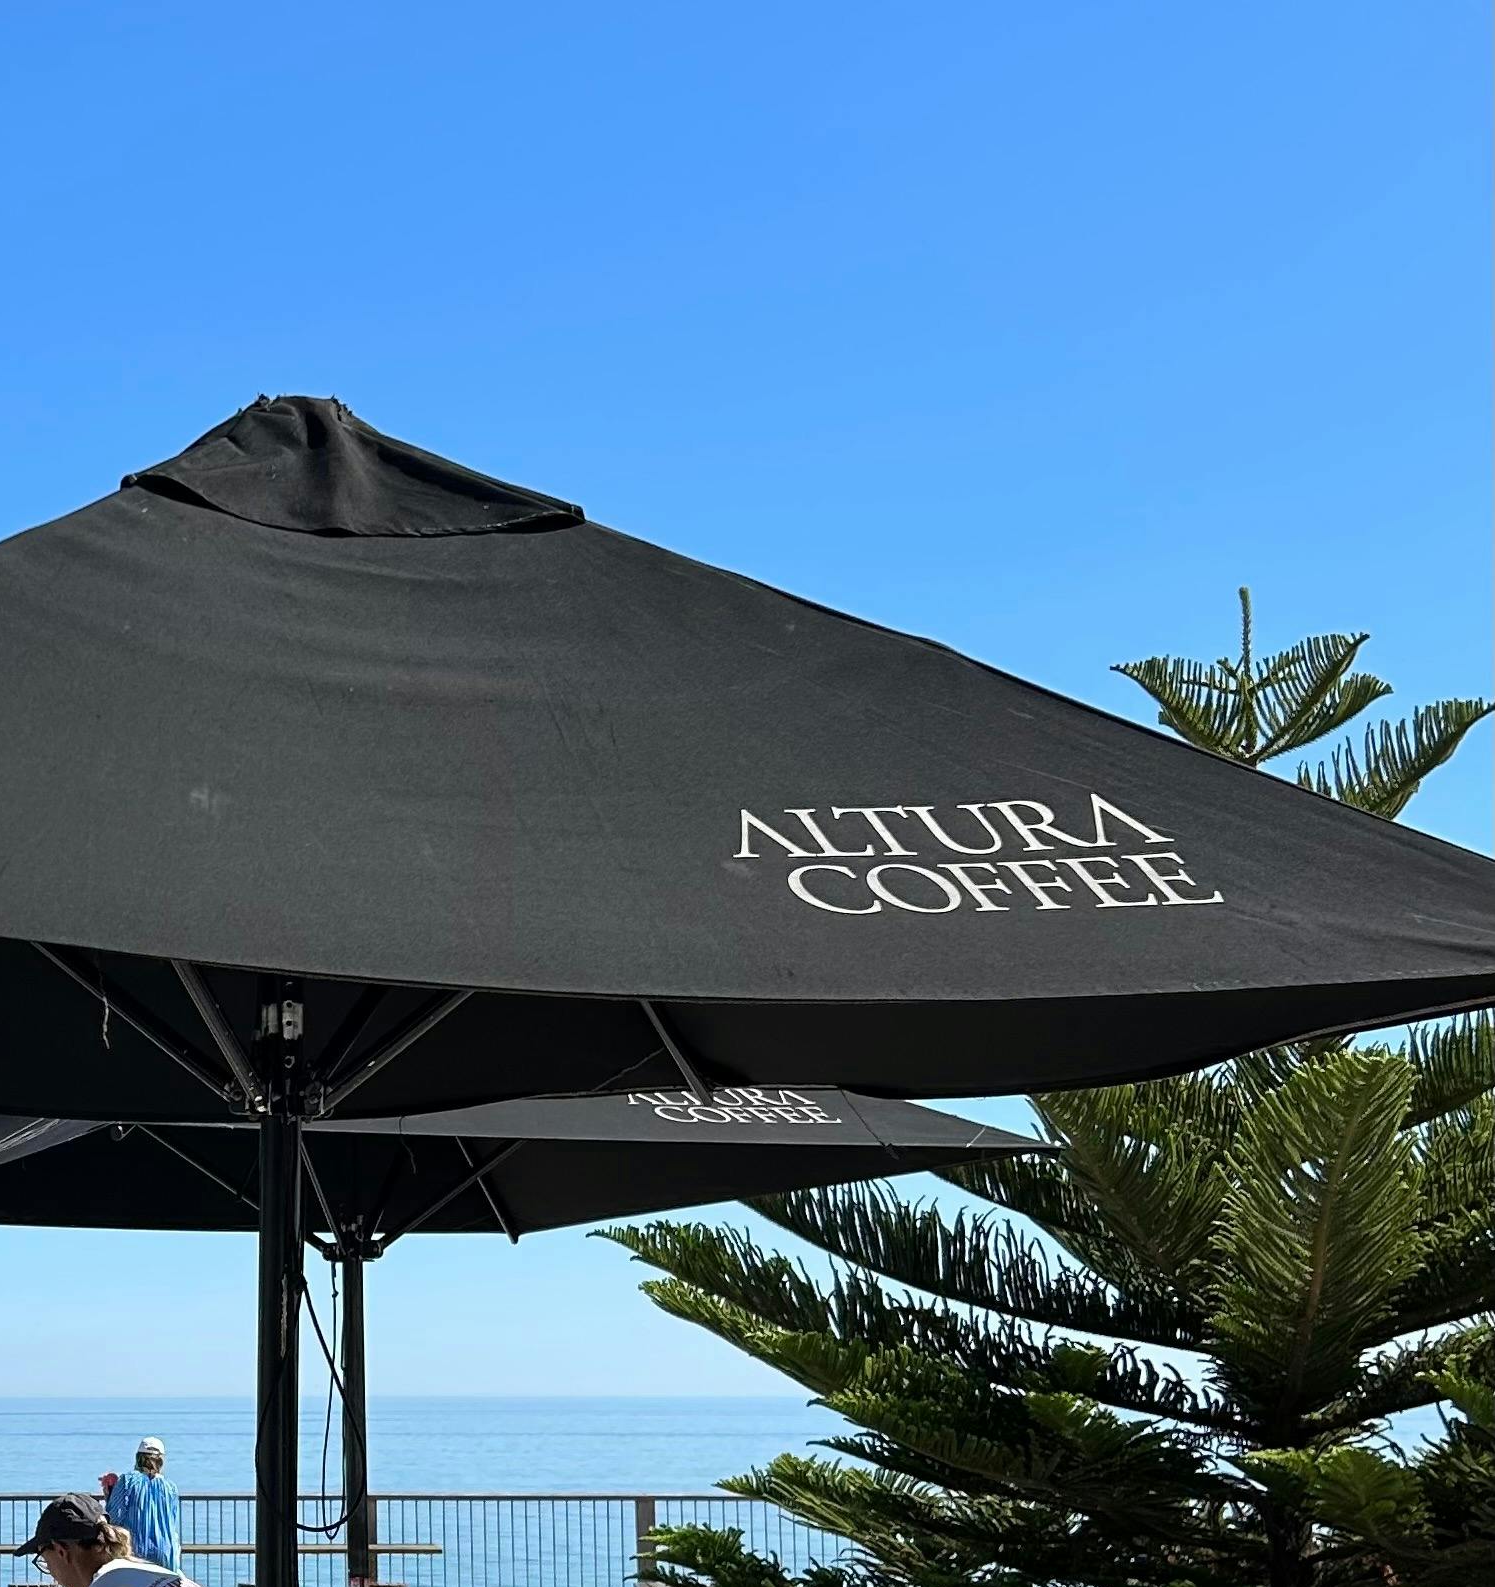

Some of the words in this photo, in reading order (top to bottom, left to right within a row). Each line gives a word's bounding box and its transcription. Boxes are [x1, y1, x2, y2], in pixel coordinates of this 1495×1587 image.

[732, 793, 1175, 858] ALTURA
[787, 852, 1225, 915] COFFEE
[654, 1105, 843, 1124] COFFEE
